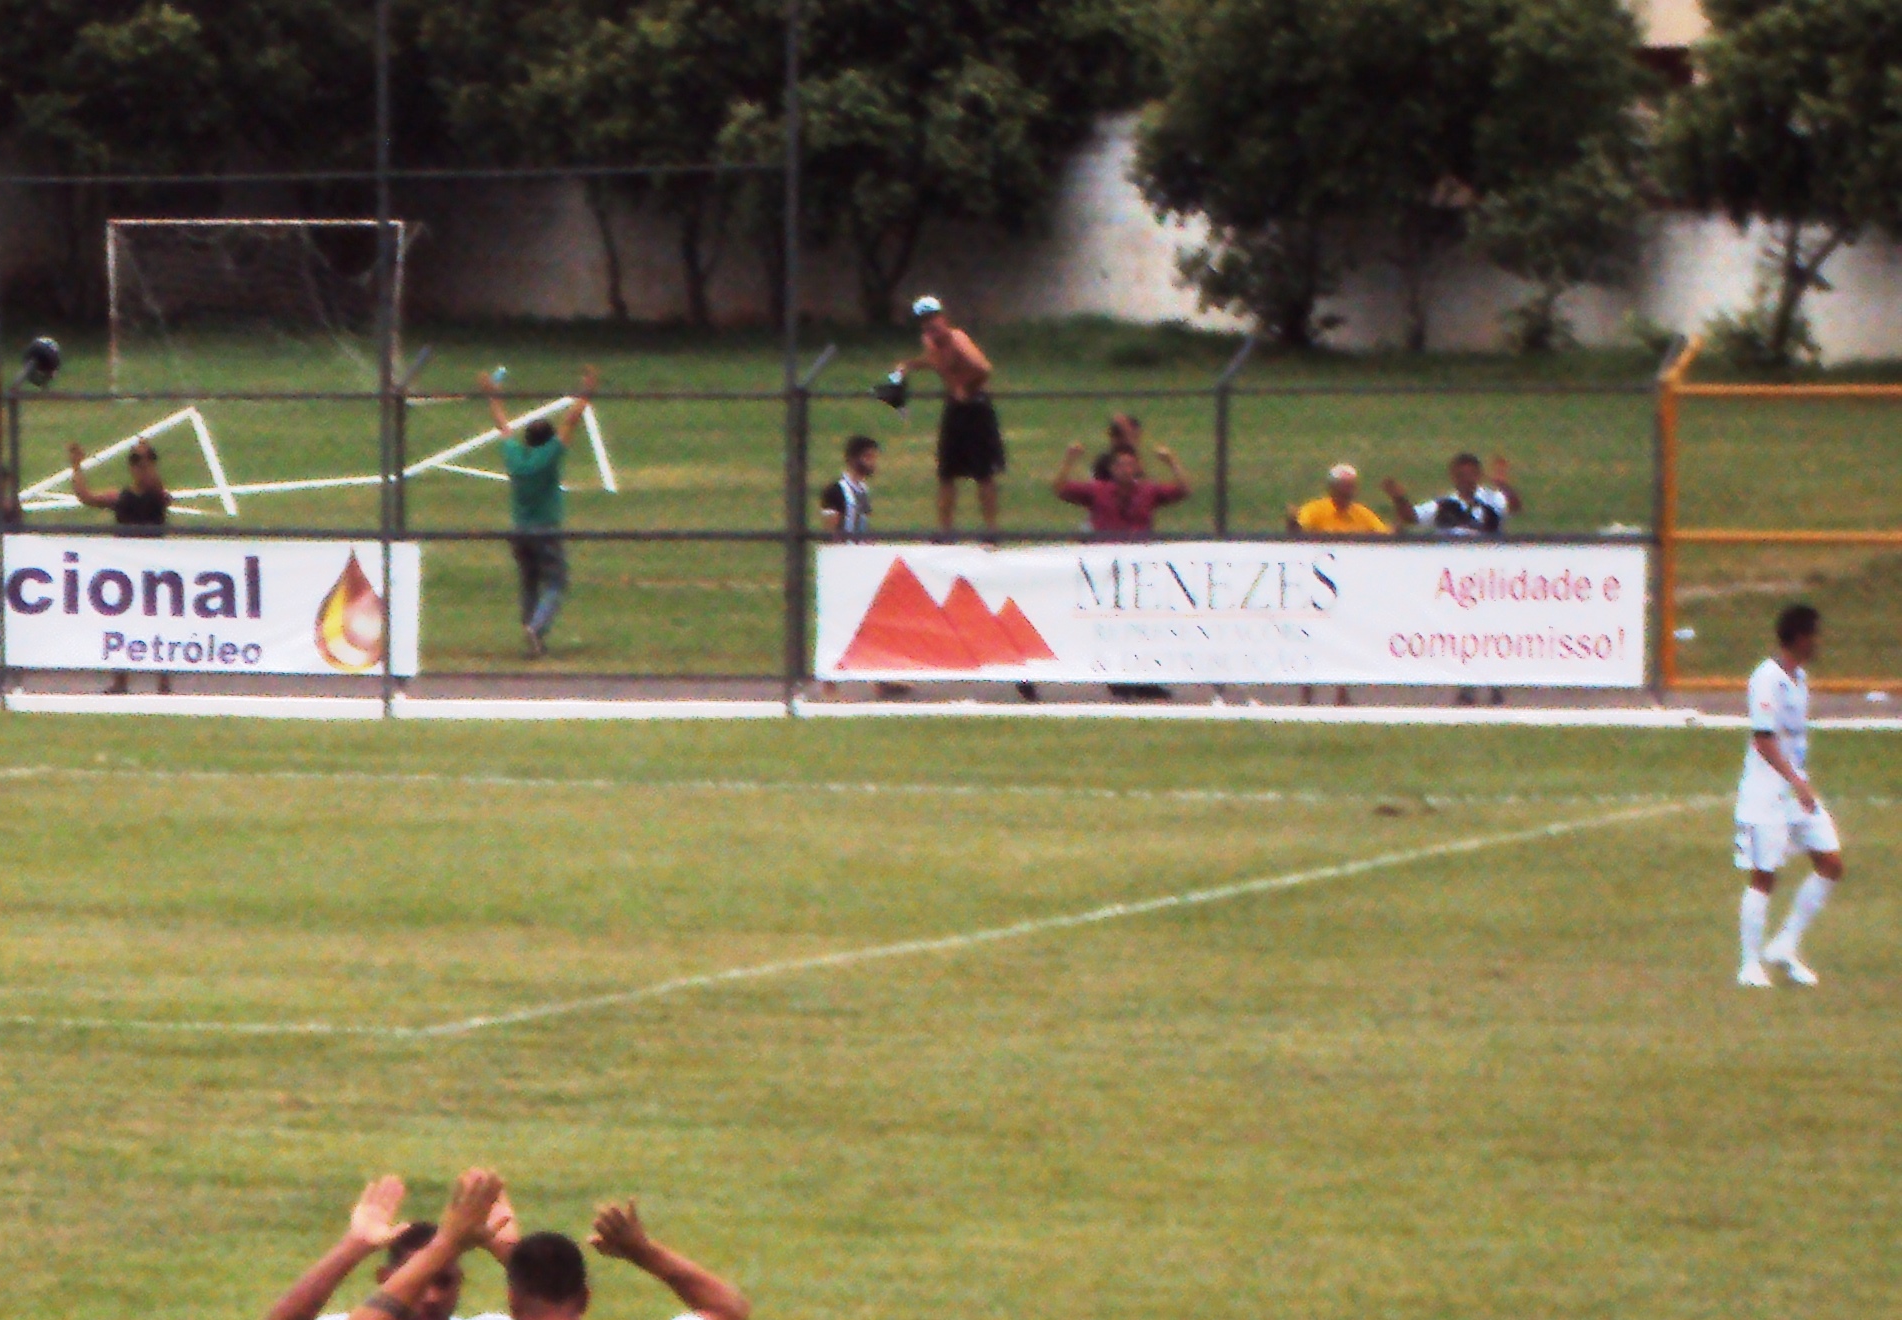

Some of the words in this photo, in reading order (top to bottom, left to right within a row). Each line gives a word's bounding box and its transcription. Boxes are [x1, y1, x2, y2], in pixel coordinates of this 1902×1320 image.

[1075, 552, 1339, 611] MENEZES
[1434, 567, 1592, 610] Agilidade
[1602, 575, 1622, 601] e
[101, 630, 263, 665] Petróleo
[1387, 624, 1627, 665] compromisso!
